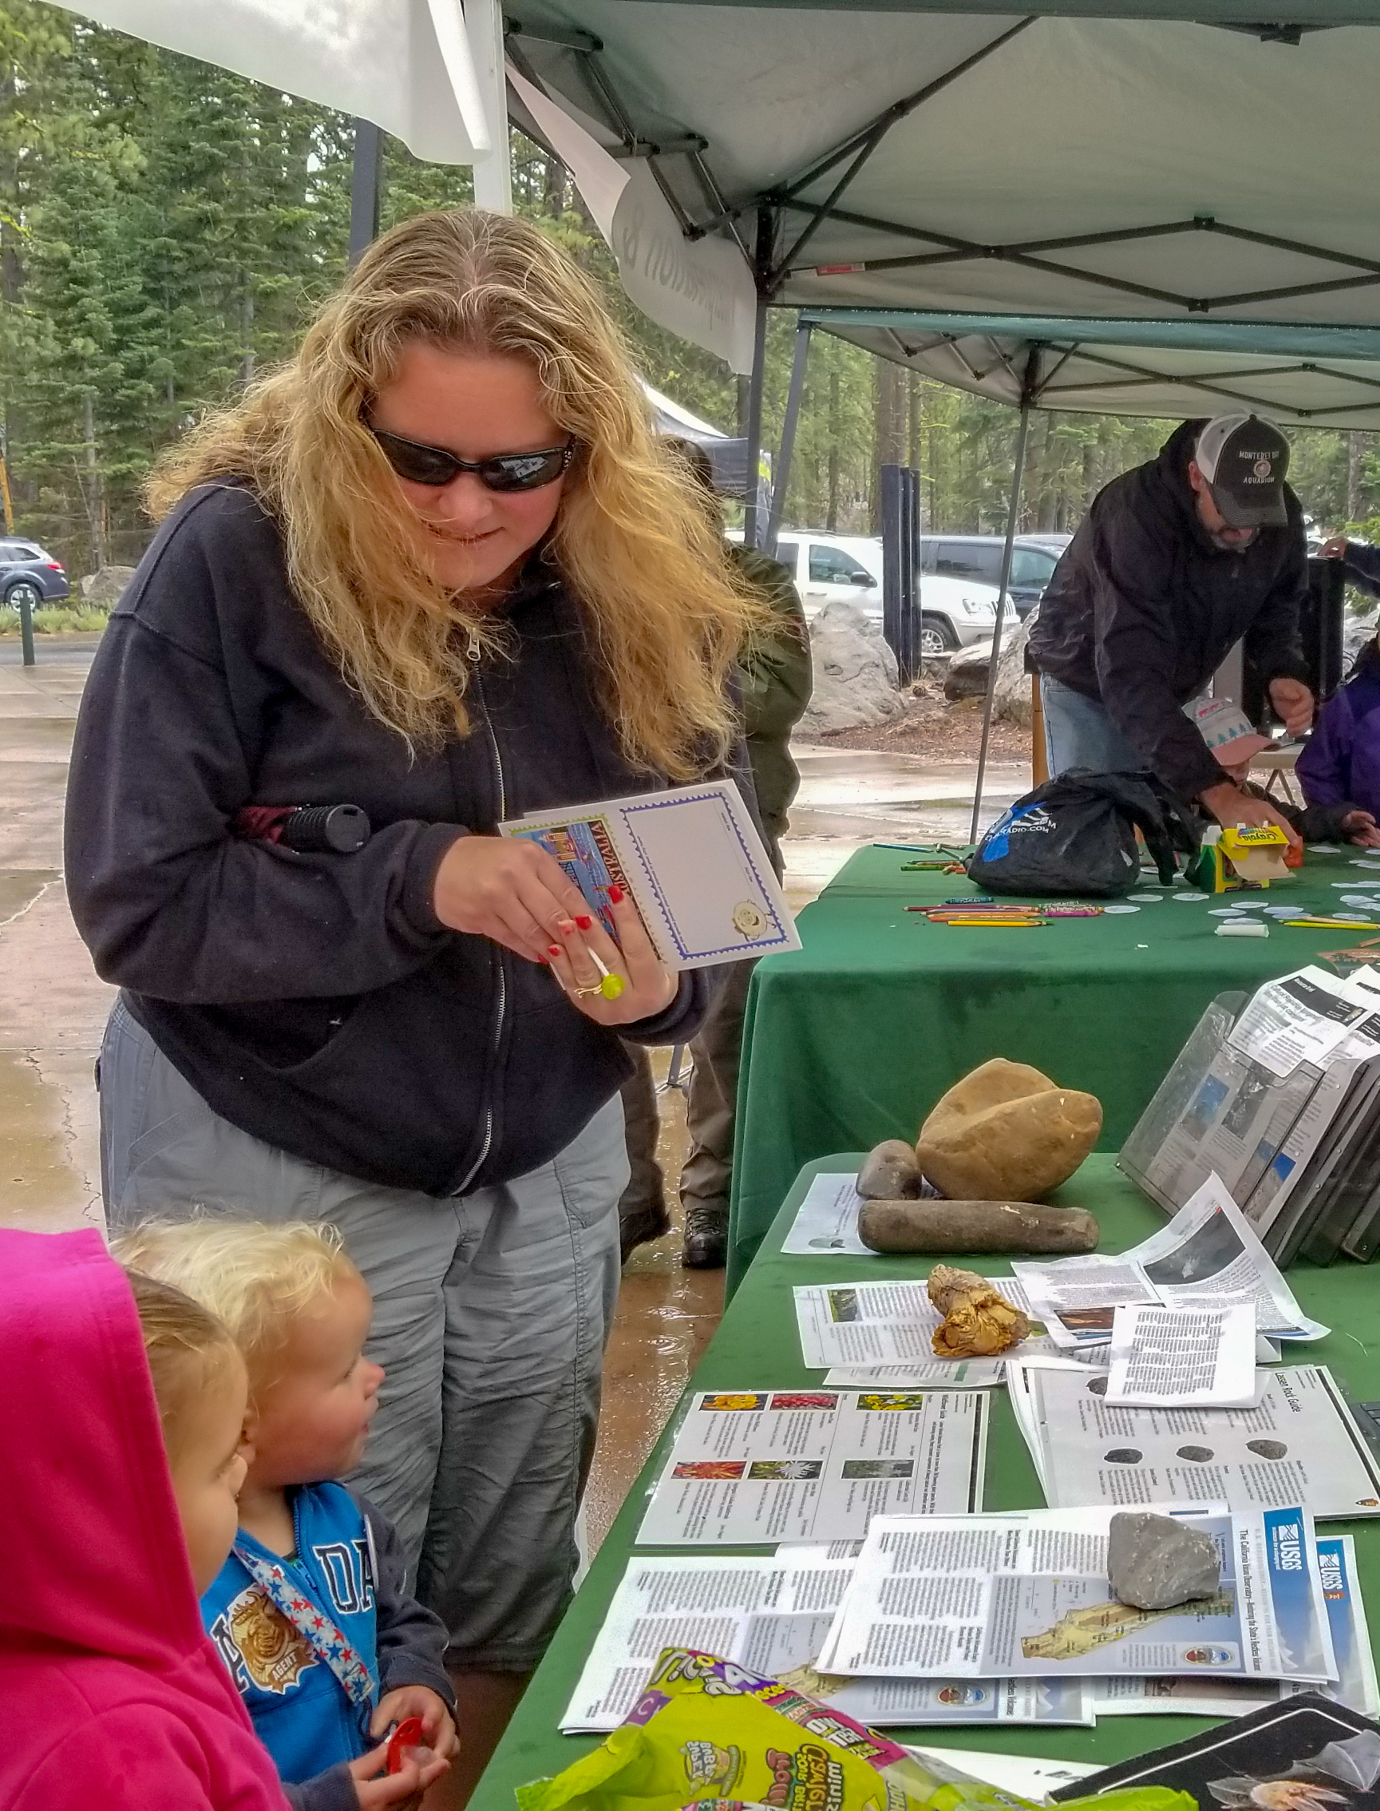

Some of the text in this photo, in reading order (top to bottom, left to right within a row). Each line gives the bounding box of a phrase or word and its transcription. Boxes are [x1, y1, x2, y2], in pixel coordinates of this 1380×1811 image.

[1238, 450, 1271, 460] MONTEREY
[1243, 476, 1275, 485] AQUARIUM
[1242, 833, 1278, 842] Crayola
[591, 821, 629, 892] USTRALIA
[1239, 1529, 1249, 1541] The
[1240, 1540, 1250, 1564] California
[1279, 1540, 1303, 1571] USGS
[1320, 1566, 1344, 1590] USGS
[271, 1652, 298, 1681] AGENT
